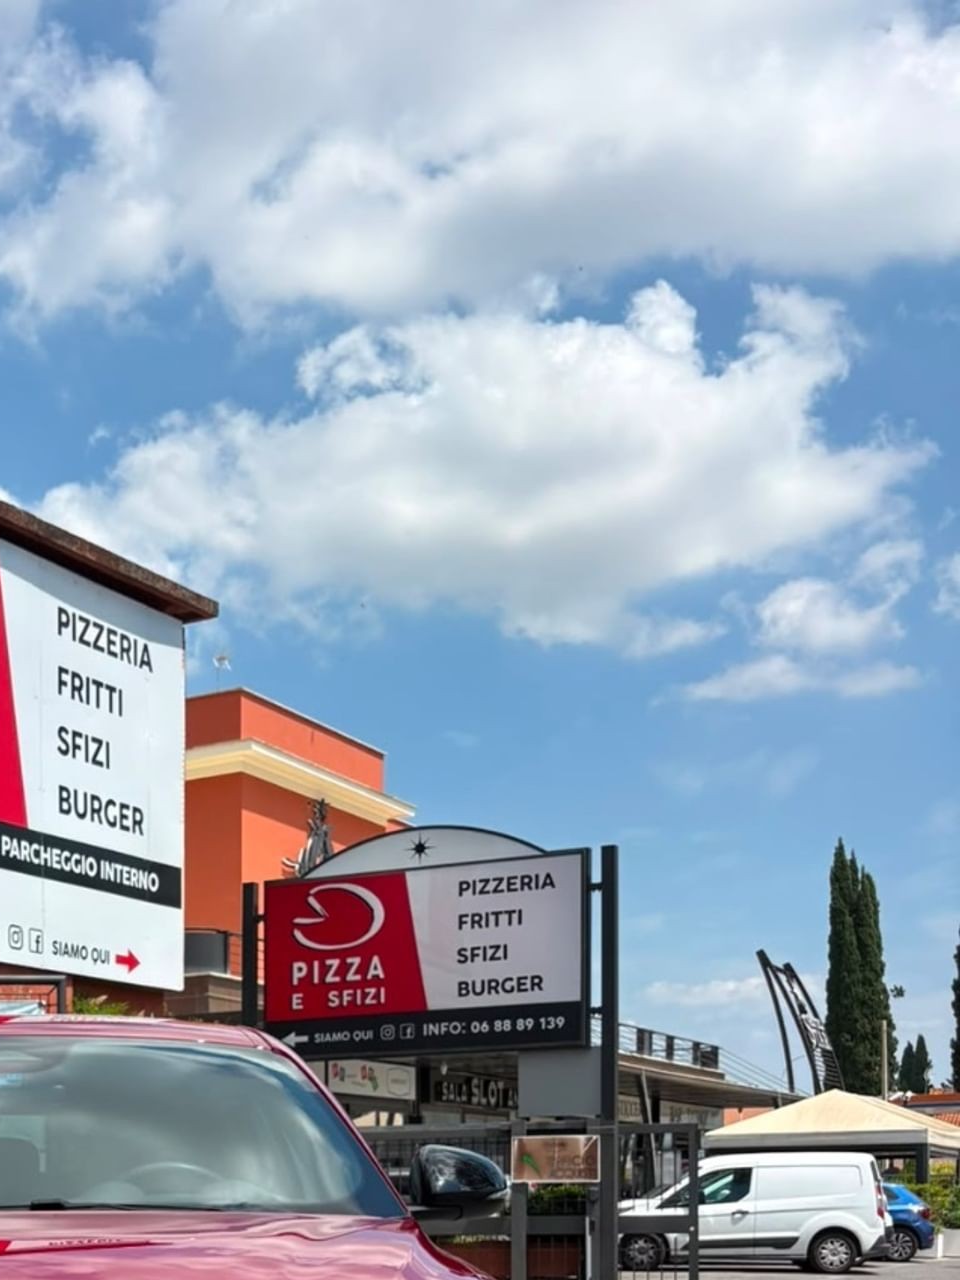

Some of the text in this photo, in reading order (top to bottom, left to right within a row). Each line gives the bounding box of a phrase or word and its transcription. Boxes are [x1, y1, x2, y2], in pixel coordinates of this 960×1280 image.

[57, 606, 153, 673] PIZZERIA
[57, 665, 123, 717] FRITTI
[56, 725, 111, 770] SFIZI
[57, 784, 145, 836] BURGER
[1, 835, 98, 877] PARCHEGGIO
[100, 860, 160, 893] INTERNO
[458, 872, 556, 897] PIZZERIA
[458, 908, 523, 931] FRITTI
[52, 940, 111, 965] SIAMO QUI
[456, 943, 509, 964] SFIZI
[292, 955, 385, 986] PIZZA
[292, 987, 385, 1010] E SFIZI
[457, 974, 544, 997] BURGER
[314, 1016, 566, 1043] SIAMO QUI INFO: 06 88 89 139
[442, 1081, 467, 1102] SALA
[471, 1077, 505, 1107] SLOT
